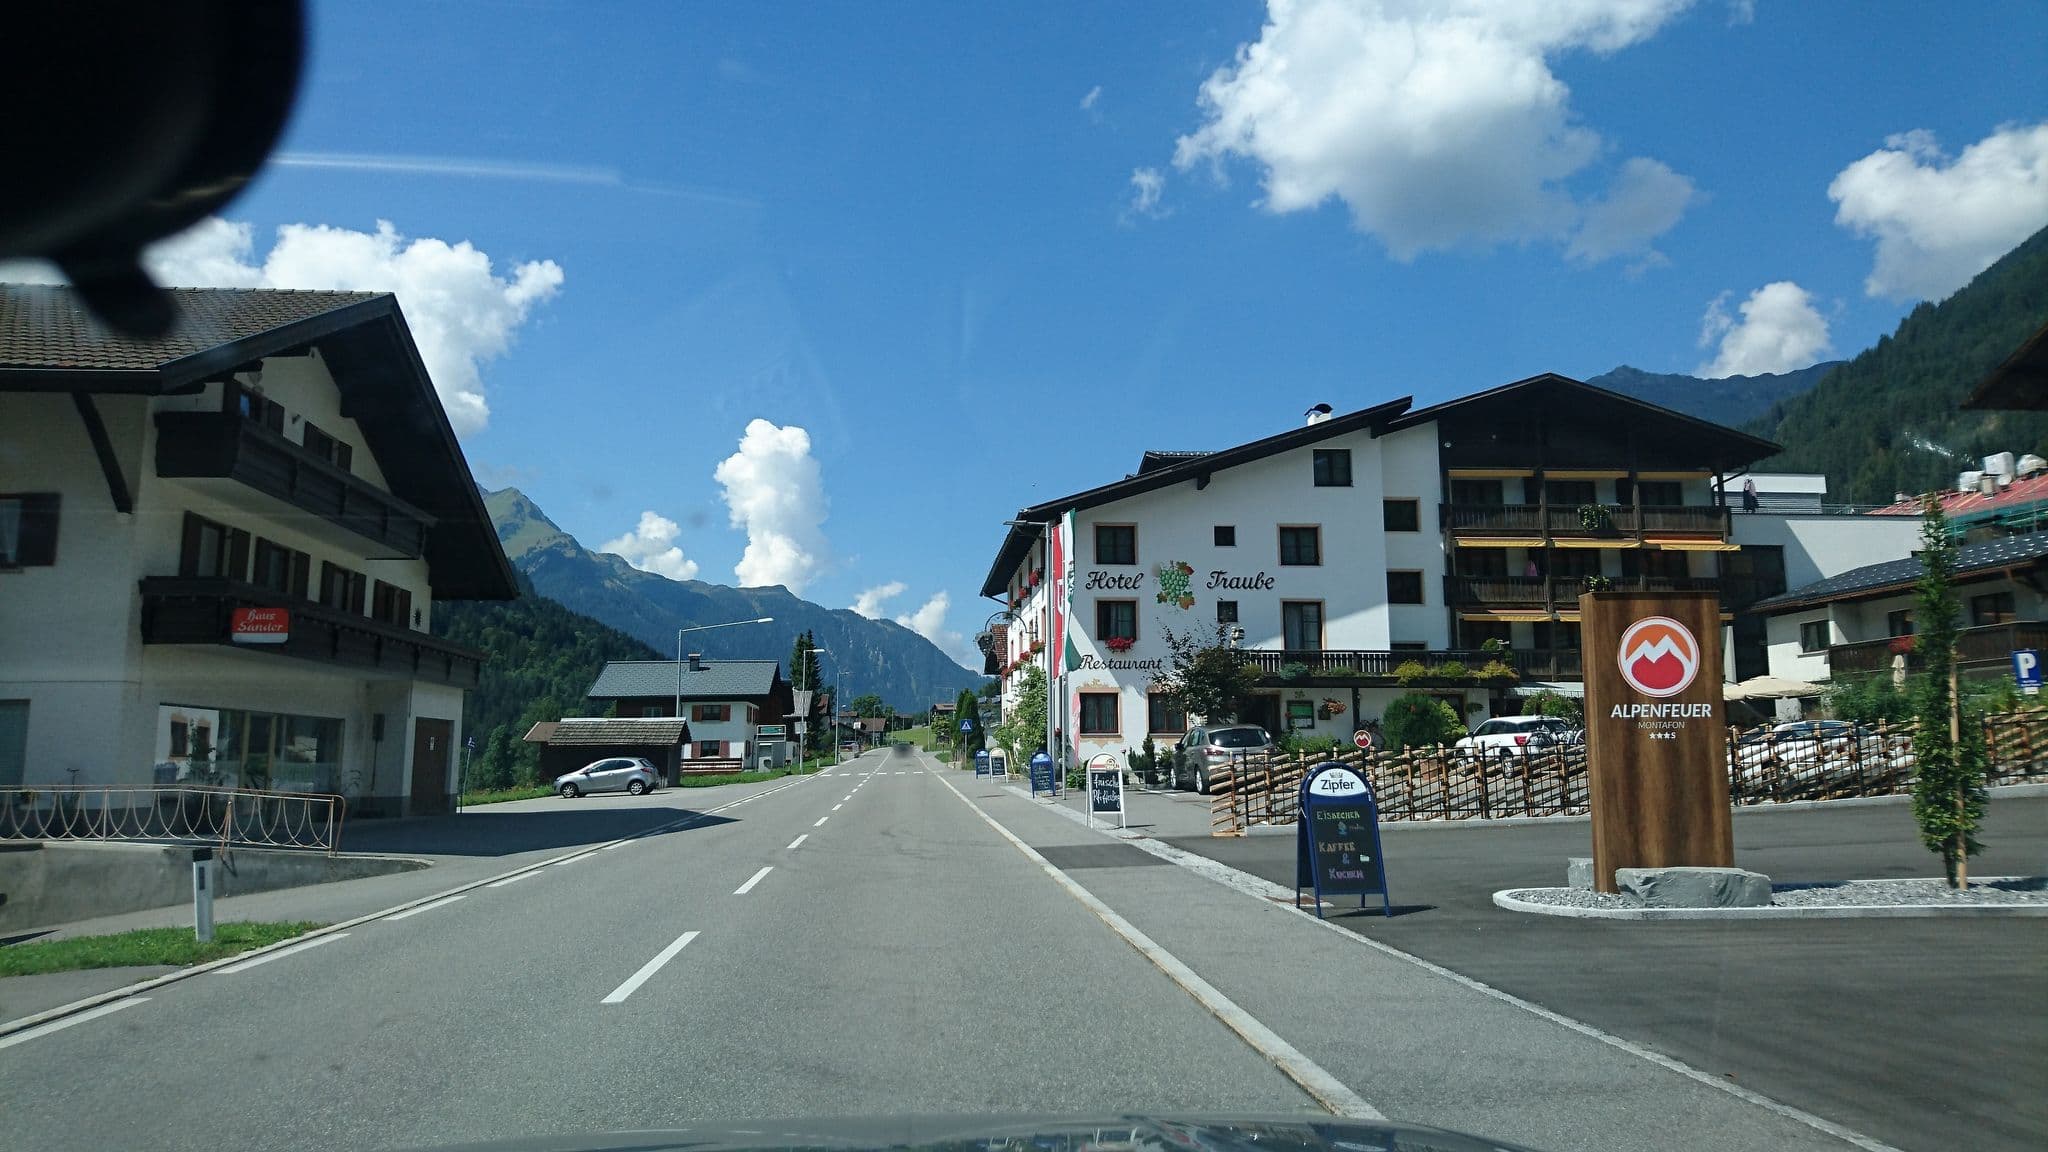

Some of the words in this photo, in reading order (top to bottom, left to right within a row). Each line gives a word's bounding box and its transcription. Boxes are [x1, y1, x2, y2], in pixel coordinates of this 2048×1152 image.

[1085, 571, 1144, 590] Hotel
[1206, 570, 1275, 590] Traube
[248, 609, 276, 622] Haus
[1080, 655, 1162, 671] Restaurant
[2016, 653, 2036, 678] P
[1610, 703, 1711, 718] ALPENFEUER
[1638, 721, 1685, 729] MONTAFON
[1320, 779, 1355, 792] Zipfer
